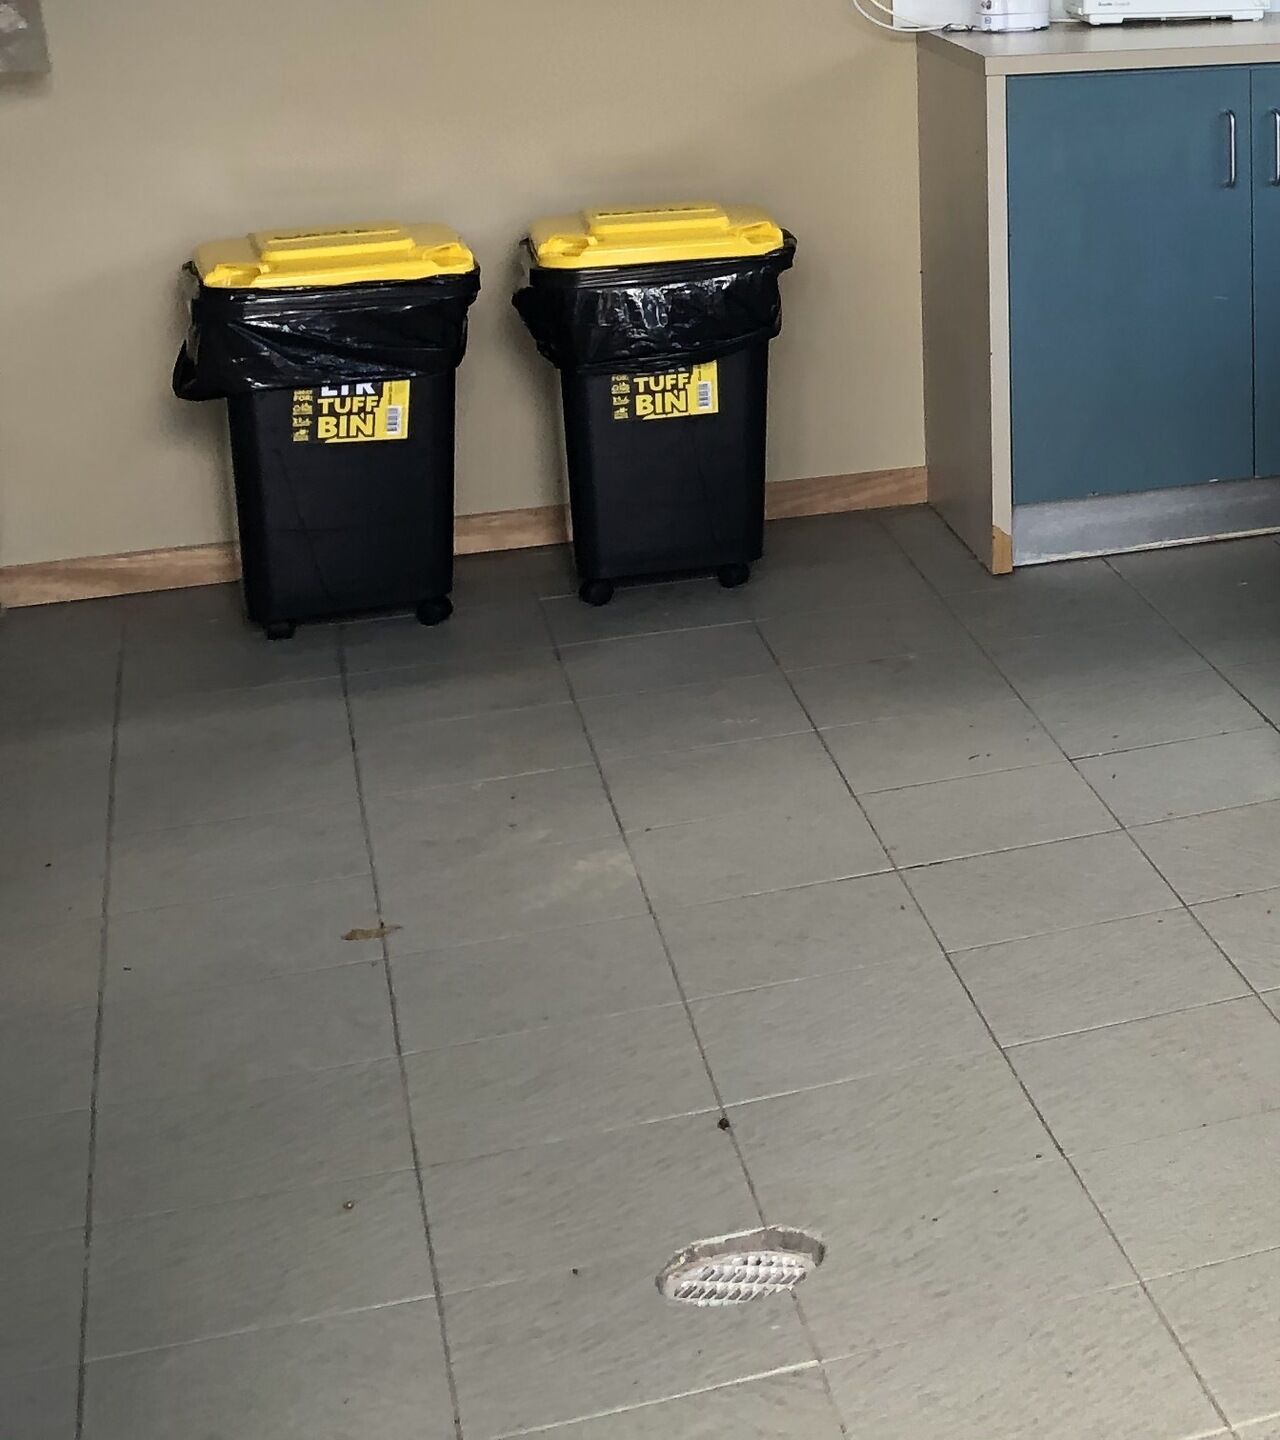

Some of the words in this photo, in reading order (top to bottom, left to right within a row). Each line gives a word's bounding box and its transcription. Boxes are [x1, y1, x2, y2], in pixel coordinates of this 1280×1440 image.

[633, 372, 690, 393] TUFF
[317, 396, 379, 414] TUFF
[636, 389, 687, 416] BIN
[318, 413, 374, 439] BIN
